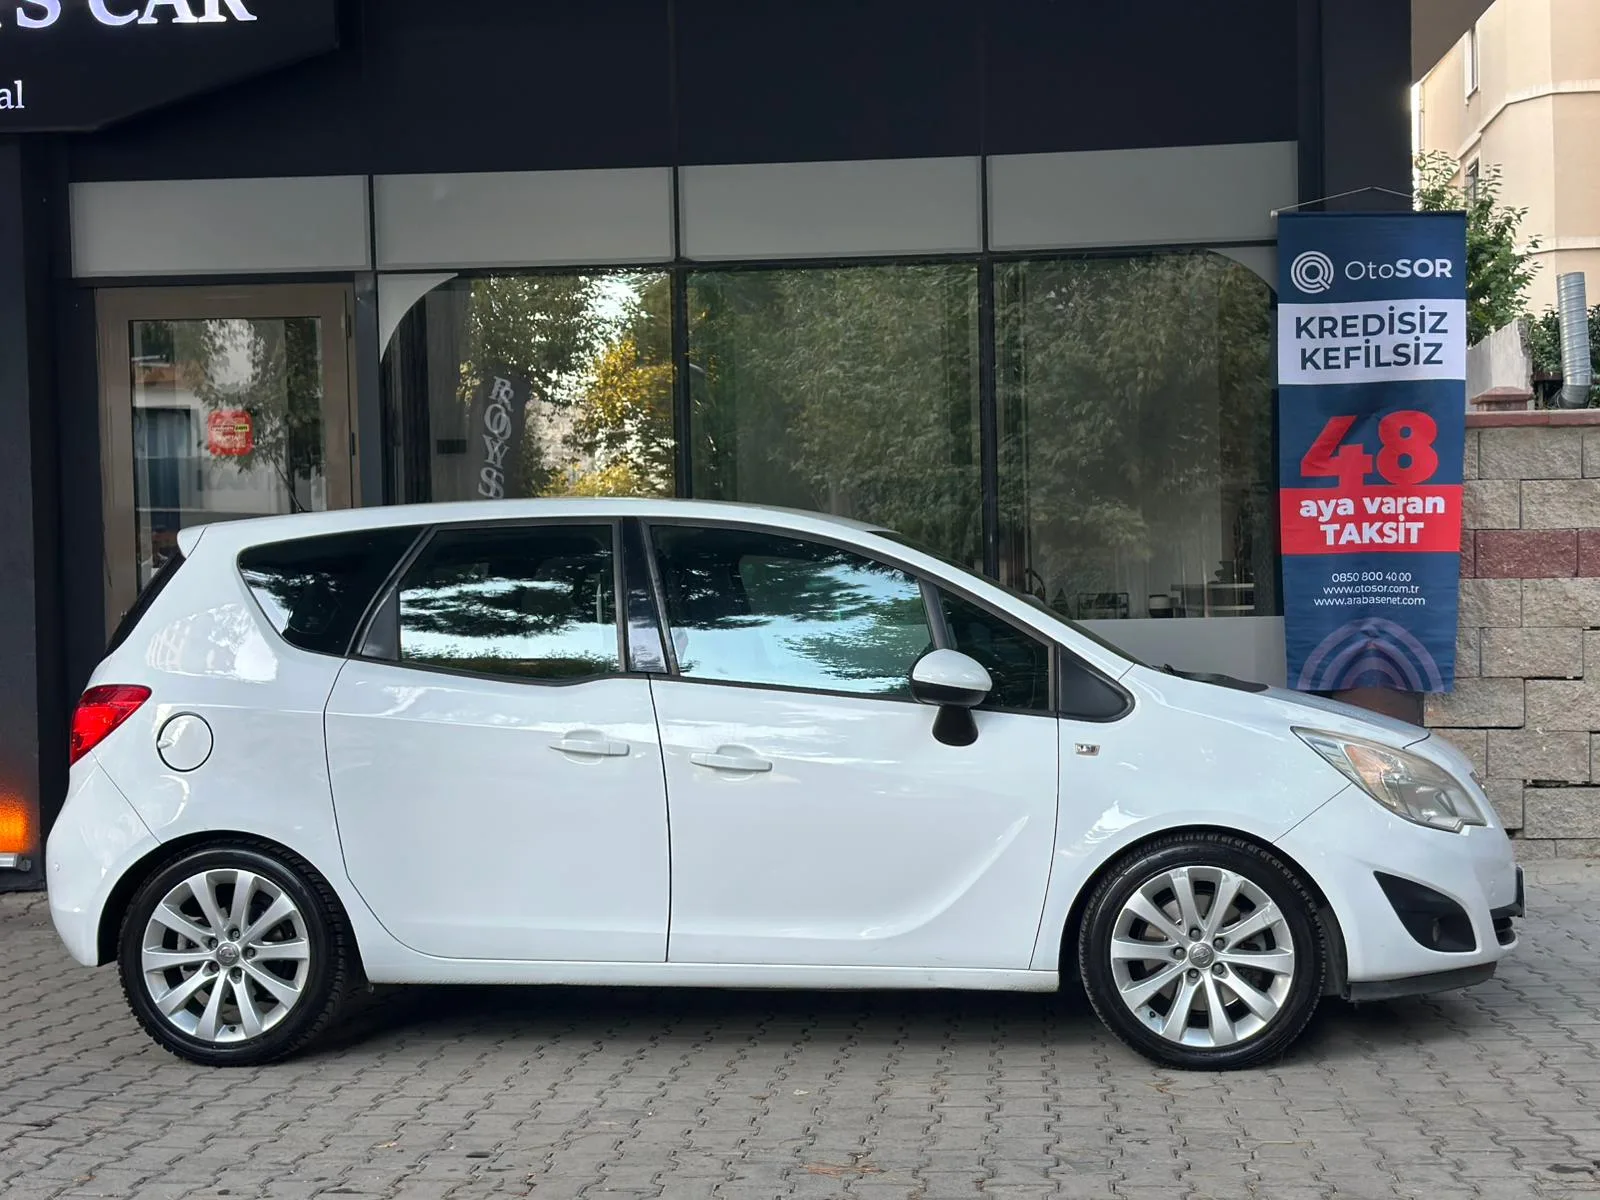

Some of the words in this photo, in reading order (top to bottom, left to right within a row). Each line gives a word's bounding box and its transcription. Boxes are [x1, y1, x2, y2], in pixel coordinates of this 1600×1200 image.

[1344, 258, 1453, 281] OtoSOR
[1295, 304, 1449, 339] KREDİSİZ
[1300, 335, 1444, 371] KEFİLSİZ
[1300, 410, 1439, 486] 48
[1299, 496, 1355, 522] aya
[1362, 495, 1446, 515] varan
[1319, 515, 1425, 546] TAKSİT
[1322, 584, 1420, 595] www.otosor.com.tr
[1331, 572, 1360, 583] 0850
[1361, 571, 1383, 581] 800
[1385, 571, 1398, 581] 40
[1398, 572, 1412, 582] 00
[1313, 594, 1426, 606] www.arabasenet.com
